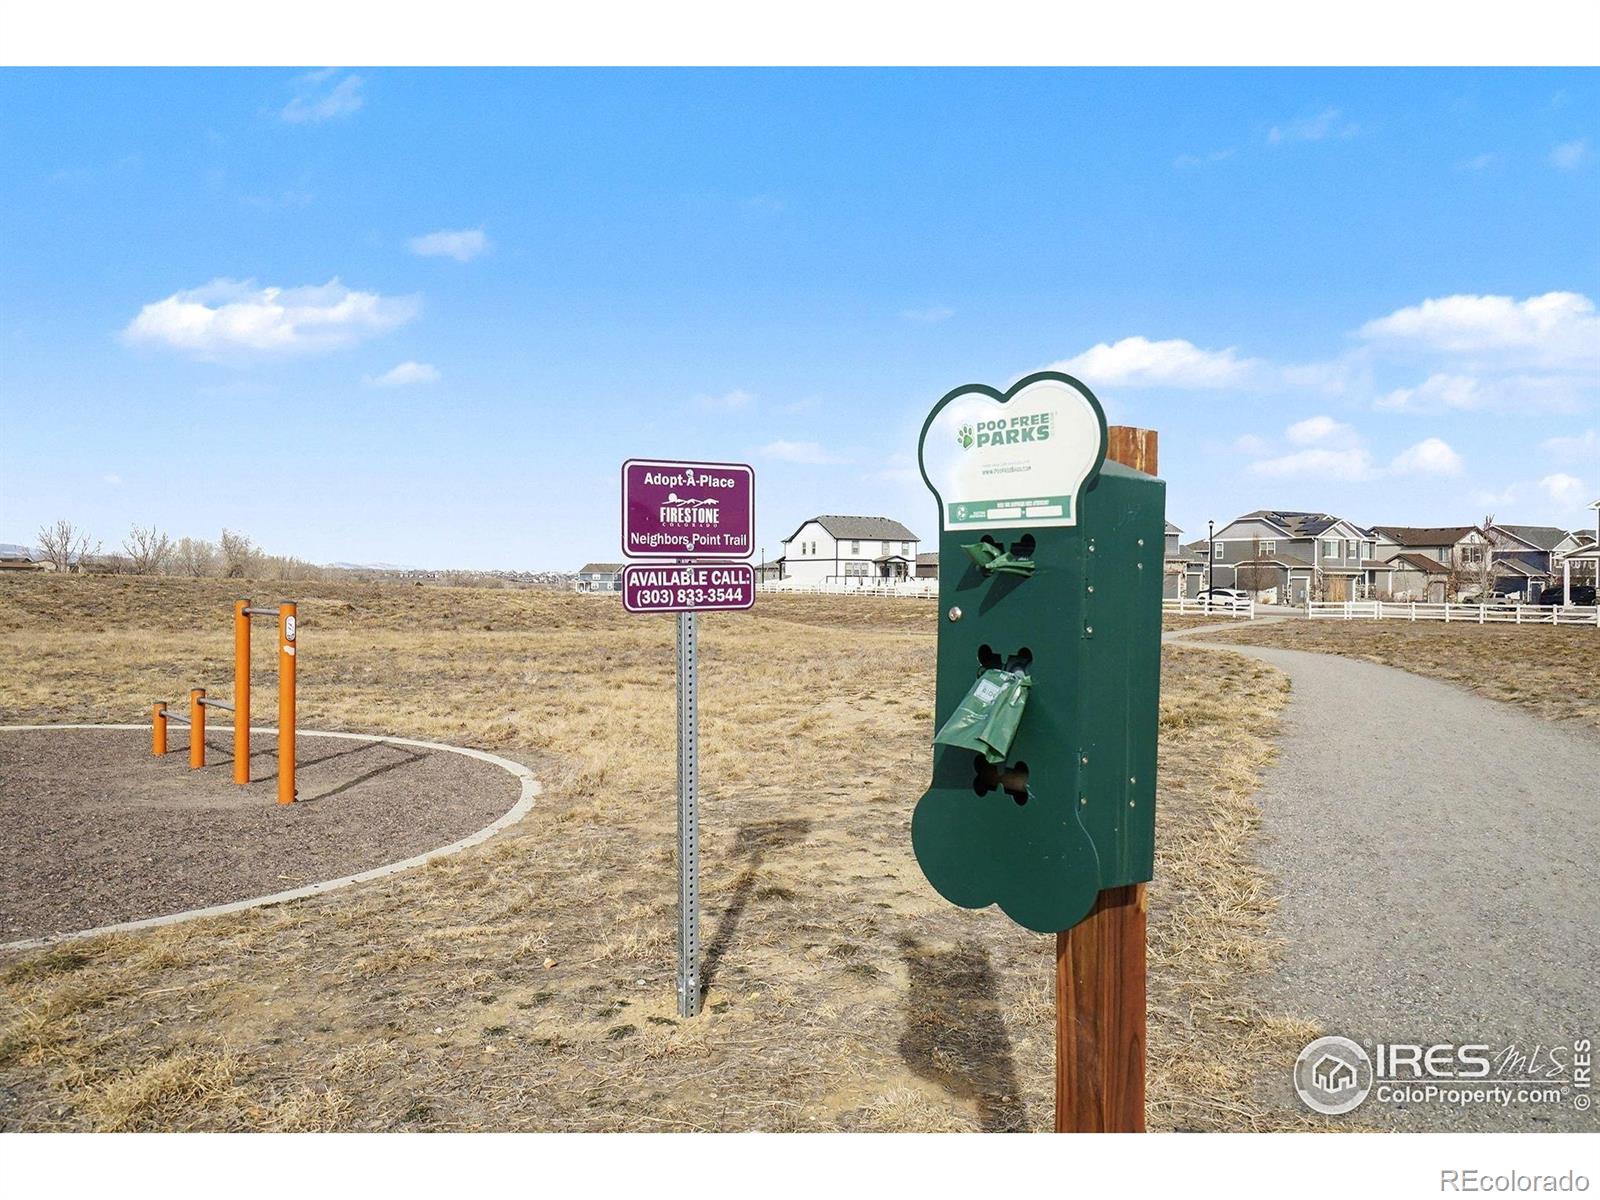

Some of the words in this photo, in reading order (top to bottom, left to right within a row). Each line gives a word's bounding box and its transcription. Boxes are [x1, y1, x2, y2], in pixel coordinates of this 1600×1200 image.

[977, 419, 1007, 433] POO
[1010, 412, 1050, 426] FREE
[976, 425, 1050, 448] PARKS
[644, 472, 735, 488] Adopt-A-Place
[660, 507, 720, 524] FIRESTONE
[631, 532, 690, 547] Neighbors
[692, 533, 721, 545] Point
[723, 534, 747, 546] Trail
[629, 571, 708, 587] AVAILABLE
[711, 570, 750, 585] CALL:
[636, 589, 674, 607] (303)
[677, 587, 743, 603] 833-3544
